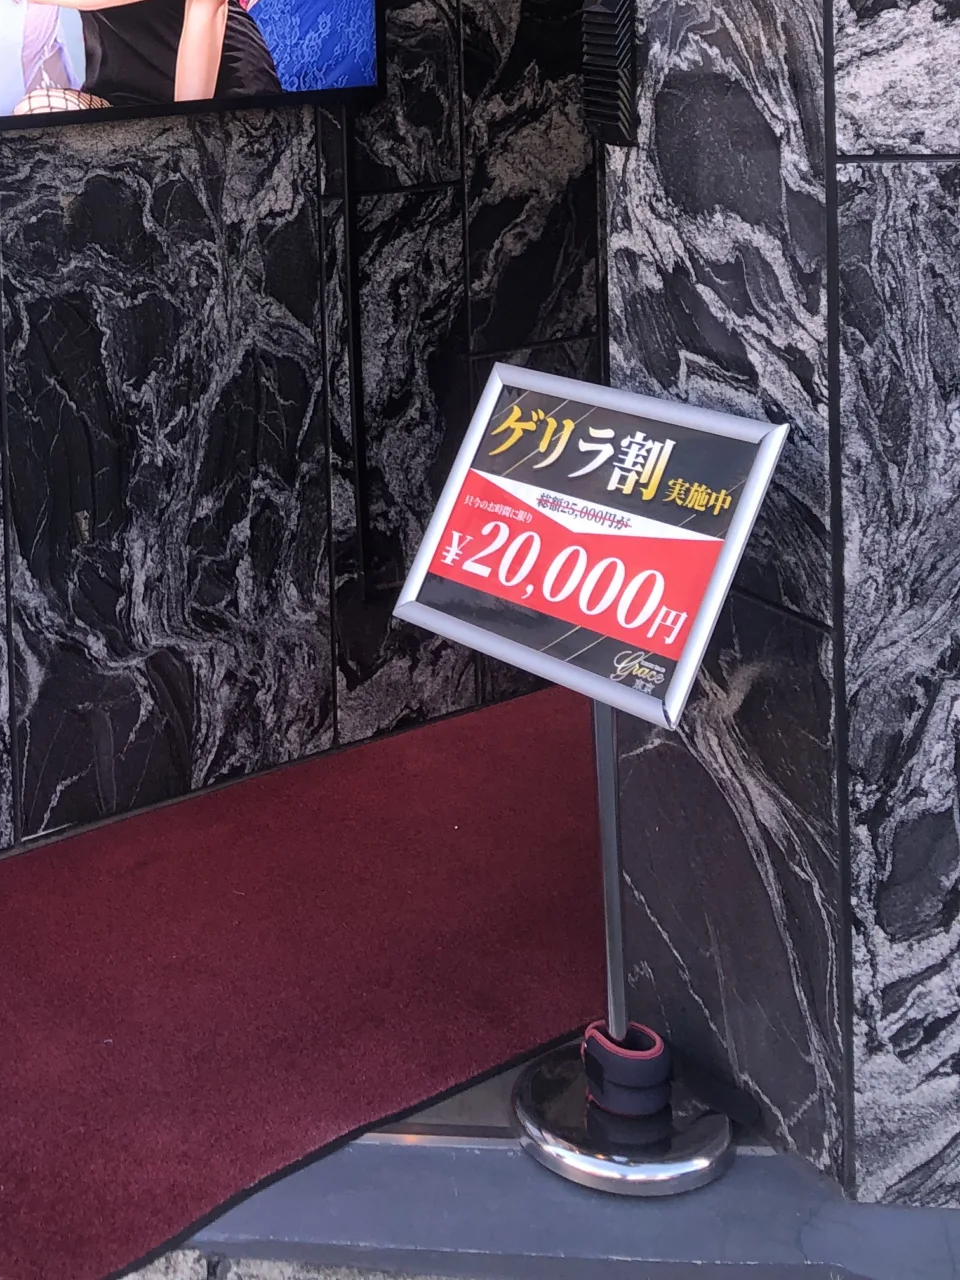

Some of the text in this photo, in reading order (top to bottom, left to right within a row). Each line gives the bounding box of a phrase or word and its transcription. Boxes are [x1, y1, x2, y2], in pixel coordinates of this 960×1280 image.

[488, 404, 734, 516] ゲリラ割 実施中
[440, 521, 689, 646] ¥20,000円
[609, 650, 665, 684] Grace
